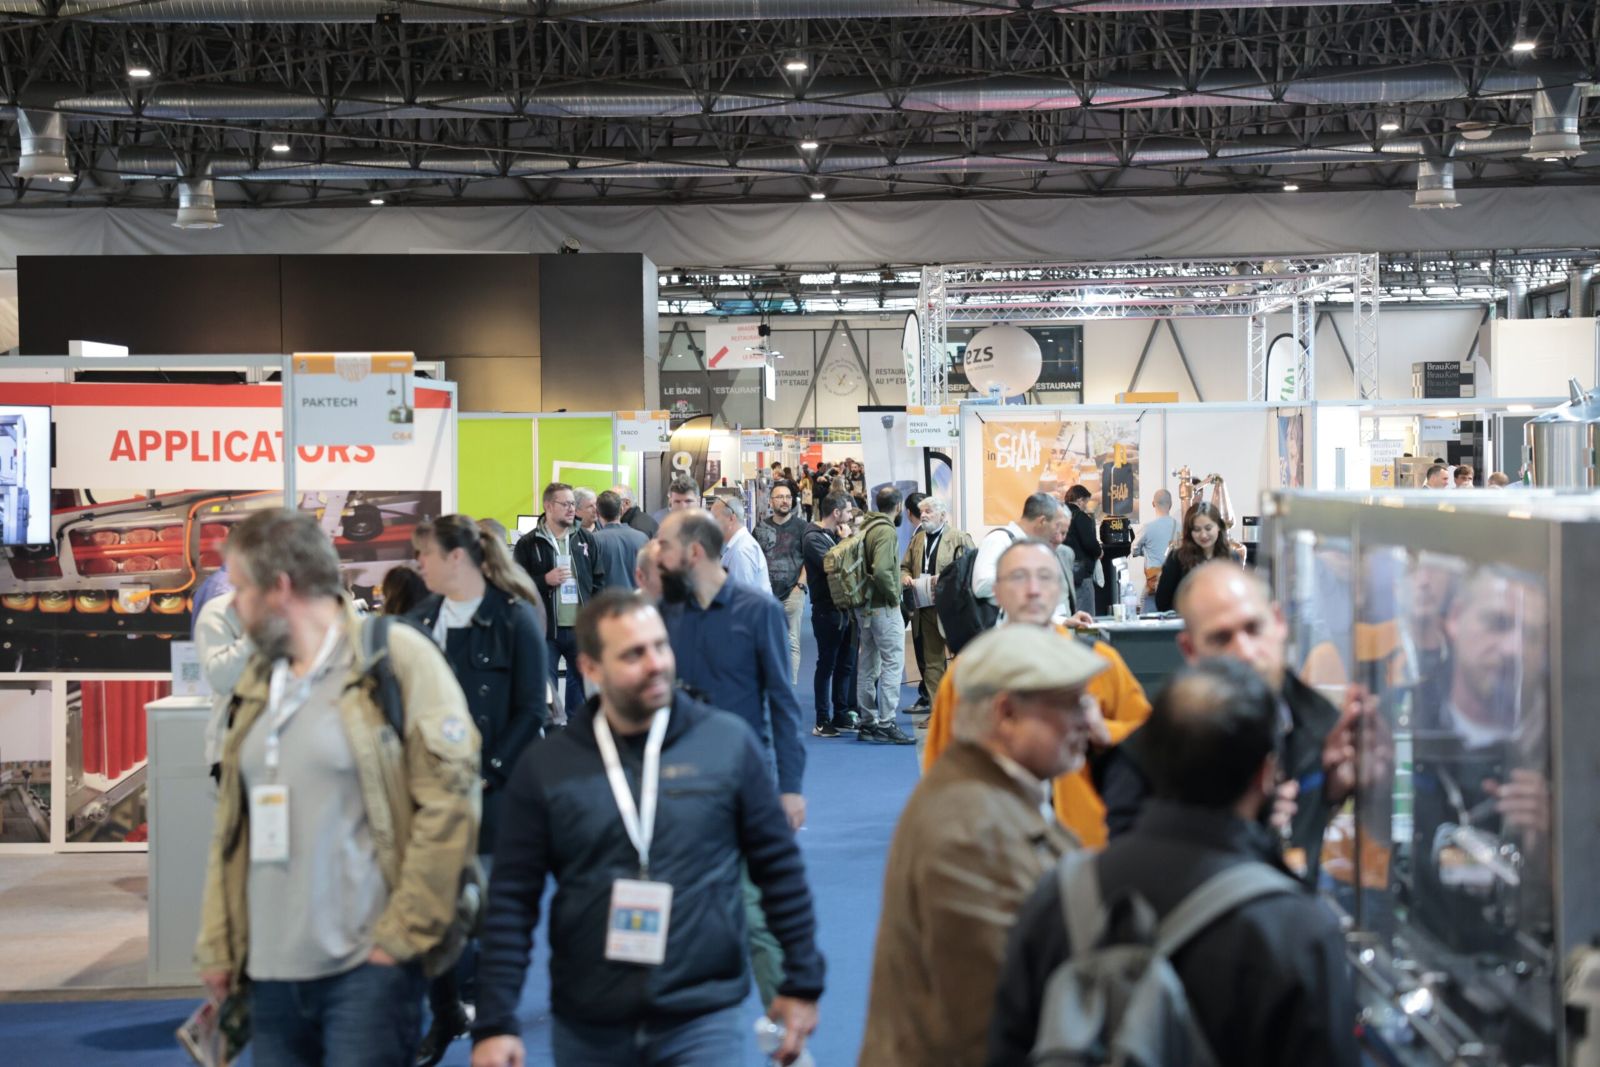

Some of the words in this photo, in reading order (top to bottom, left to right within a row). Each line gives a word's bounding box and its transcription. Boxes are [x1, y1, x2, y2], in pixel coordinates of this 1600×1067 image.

[1427, 362, 1459, 371] BrauKon
[664, 387, 674, 395] LE
[676, 387, 701, 395] BAZIN
[713, 386, 760, 394] ESTAURANT
[1034, 382, 1082, 391] ESTAURANT
[302, 397, 358, 408] PAKTECH
